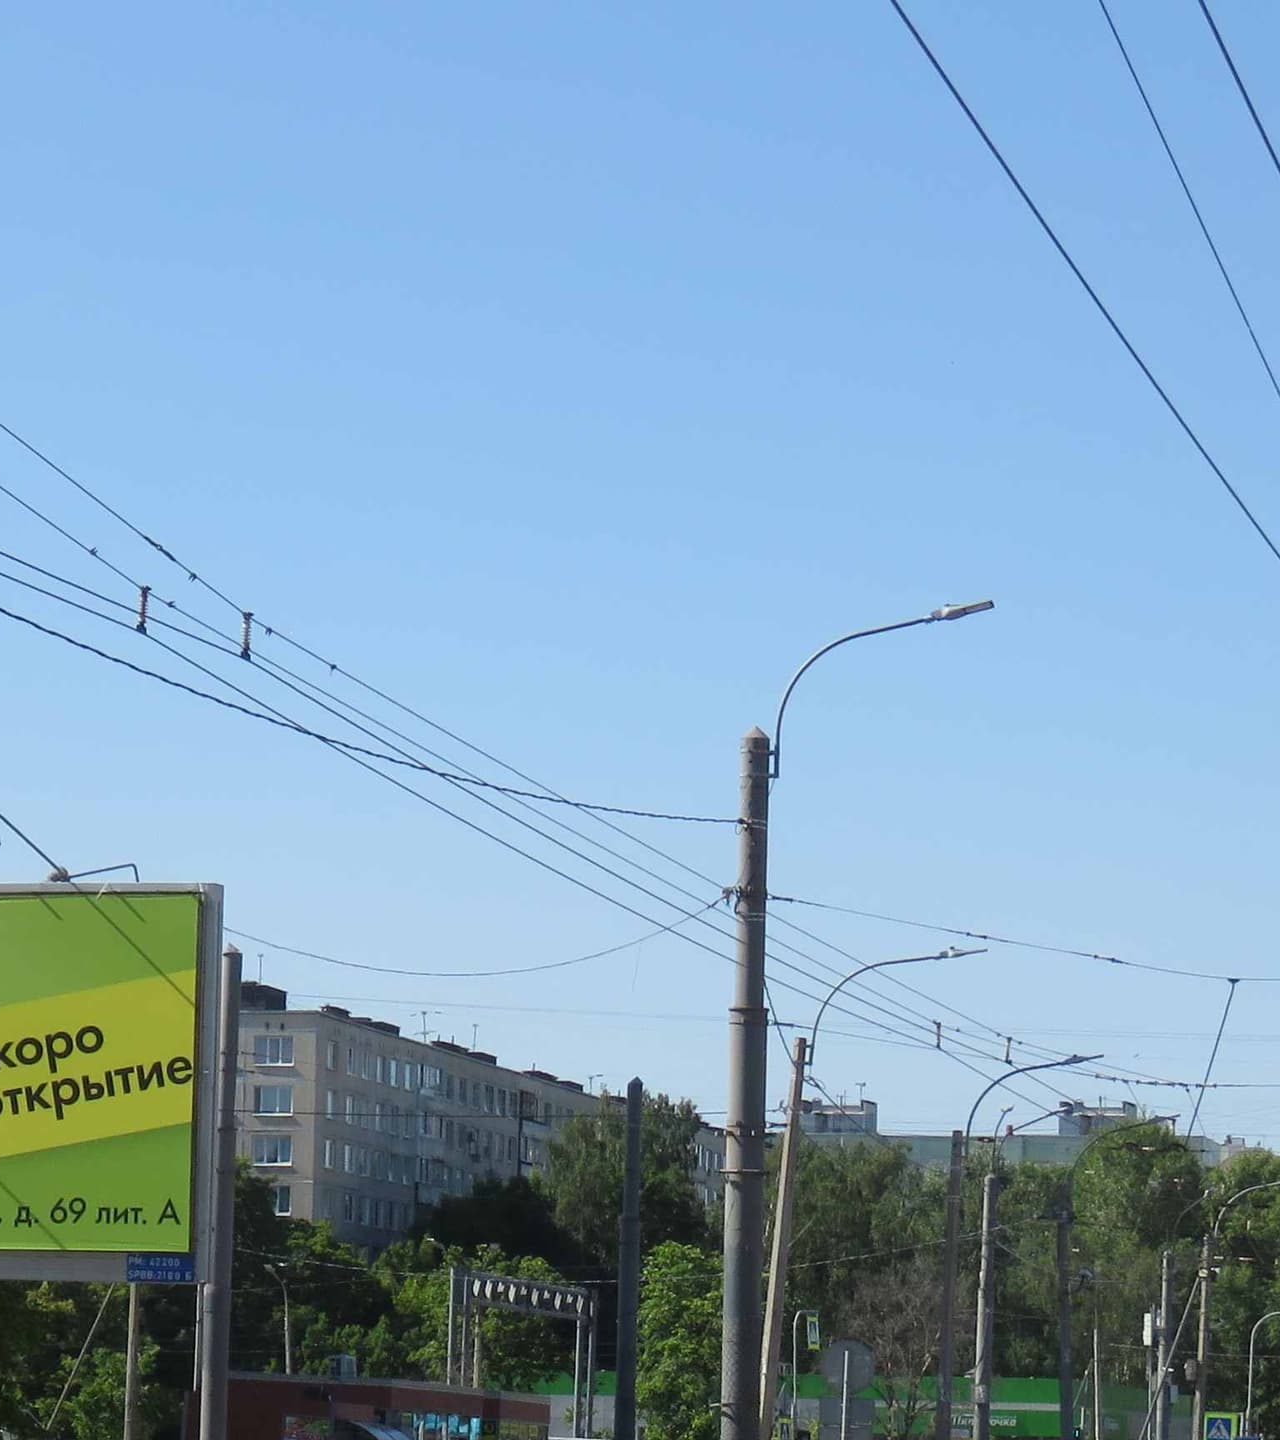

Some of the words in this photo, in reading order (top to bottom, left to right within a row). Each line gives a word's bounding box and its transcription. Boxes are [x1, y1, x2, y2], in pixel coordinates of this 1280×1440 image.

[14, 1206, 40, 1229] д.
[50, 1198, 87, 1225] 69
[95, 1206, 148, 1226] лит.
[157, 1201, 181, 1226] А
